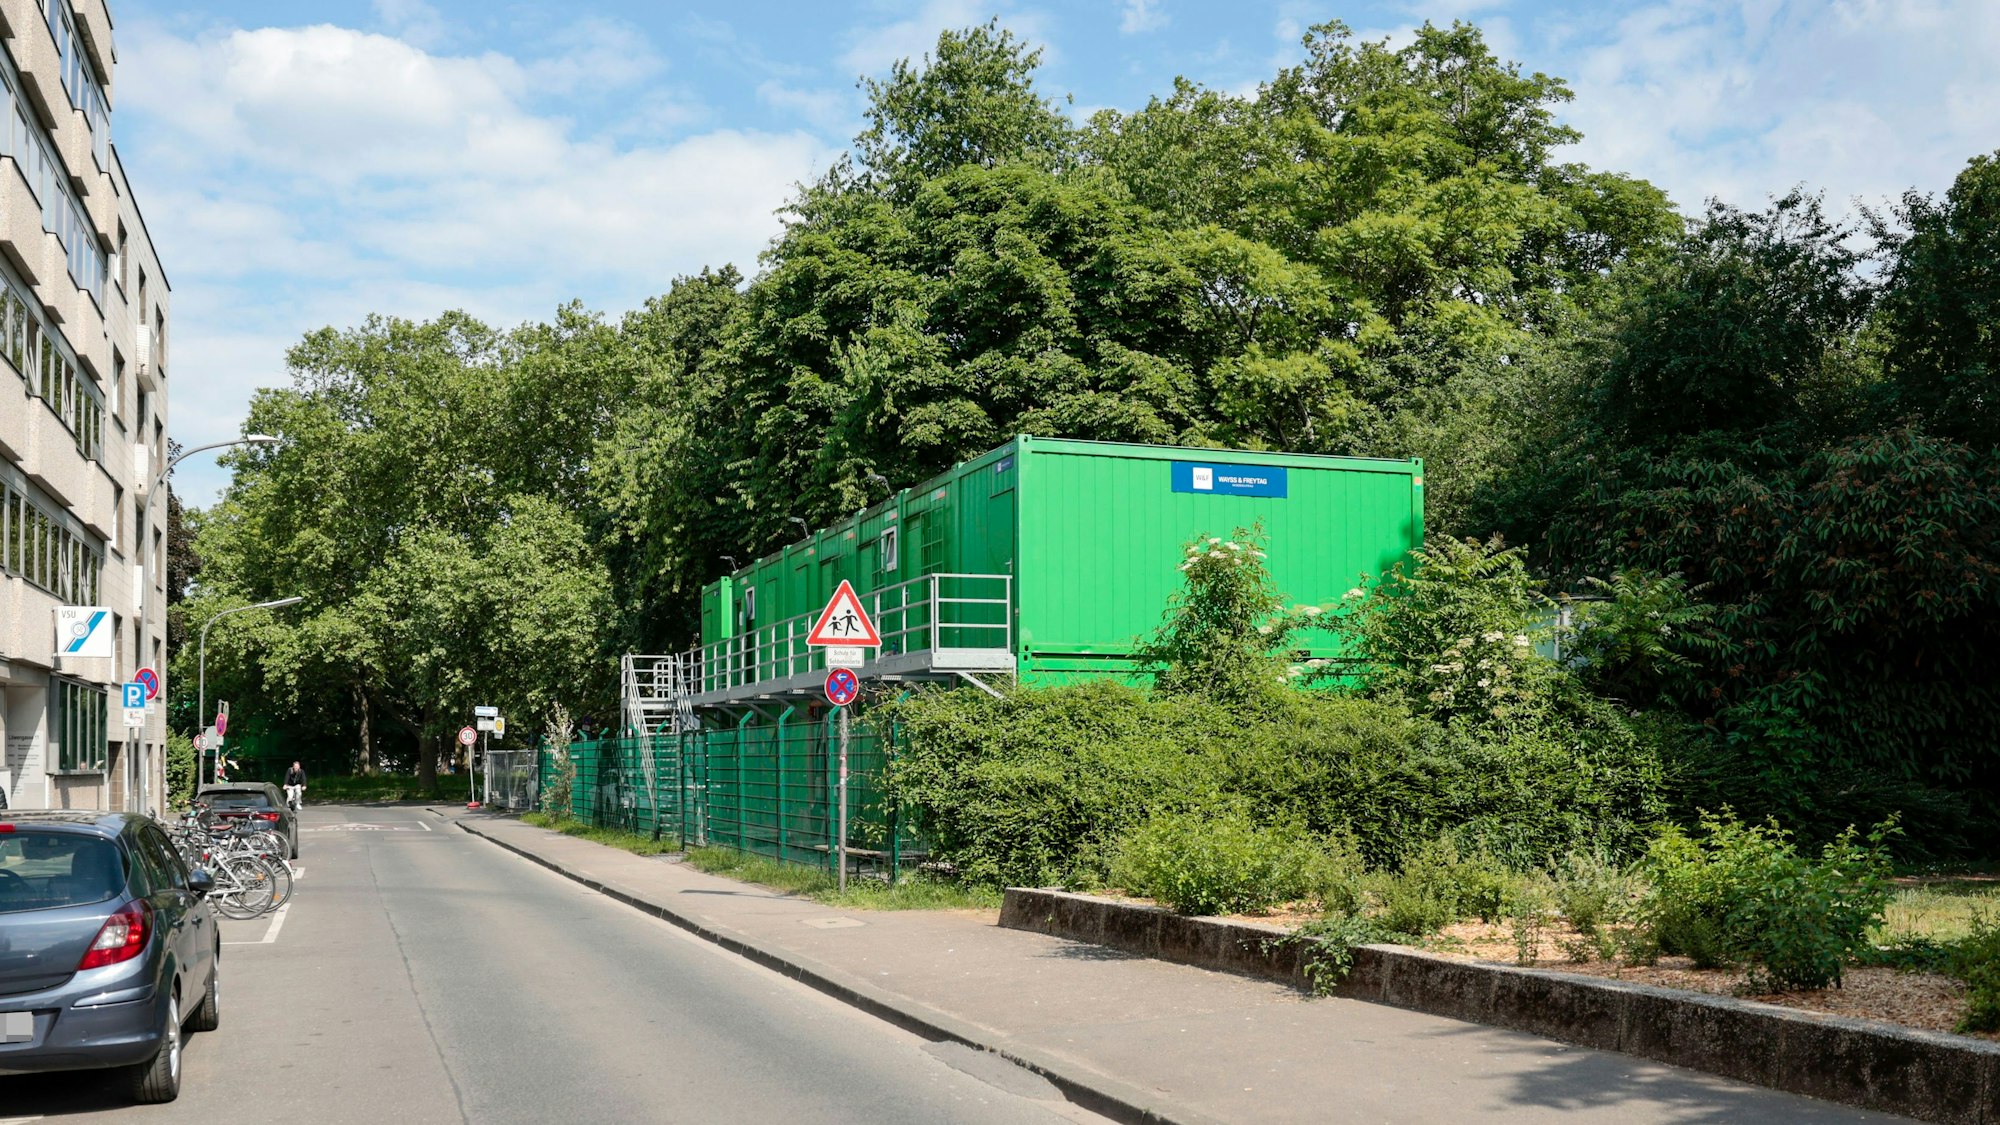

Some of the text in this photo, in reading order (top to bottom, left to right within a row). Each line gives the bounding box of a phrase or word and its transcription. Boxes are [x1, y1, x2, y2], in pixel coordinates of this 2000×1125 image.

[1243, 477, 1267, 485] FREYTAG
[61, 610, 76, 618] VSU
[127, 686, 141, 707] P
[464, 732, 473, 740] 30
